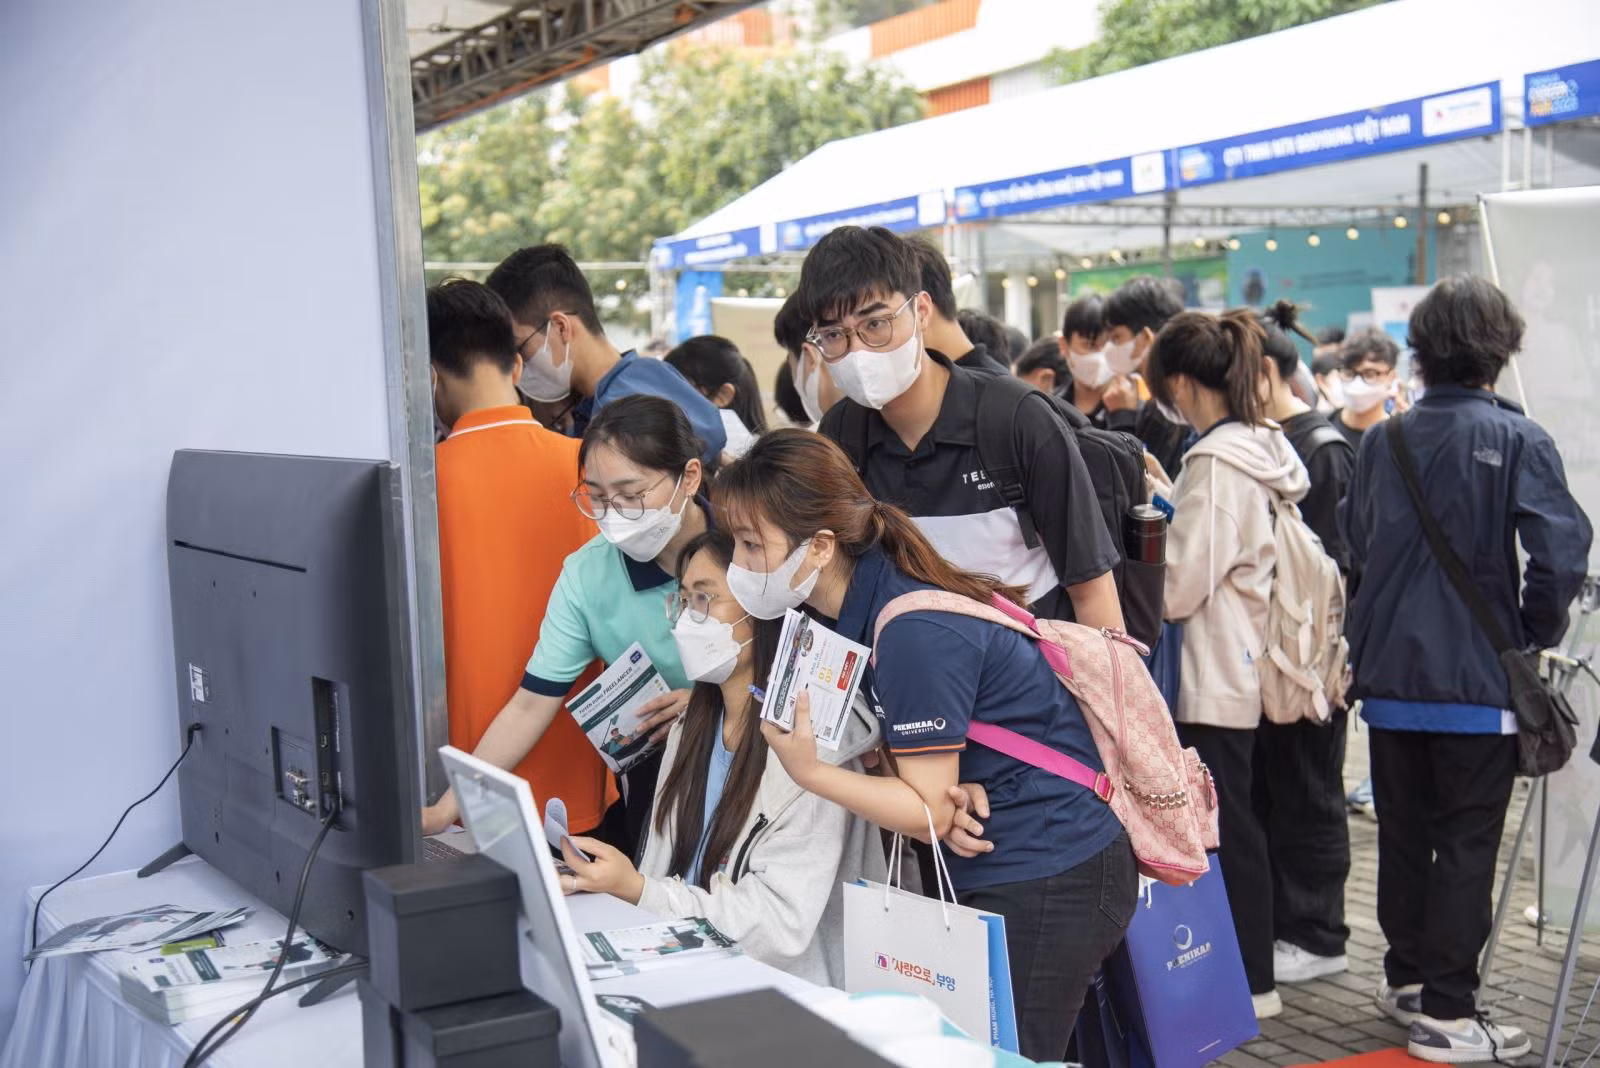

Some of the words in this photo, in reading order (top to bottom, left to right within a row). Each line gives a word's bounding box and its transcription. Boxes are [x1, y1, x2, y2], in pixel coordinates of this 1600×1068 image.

[892, 720, 934, 732] PHENIKAA
[901, 727, 934, 736] UNIVERSITY
[936, 972, 956, 992] 부영
